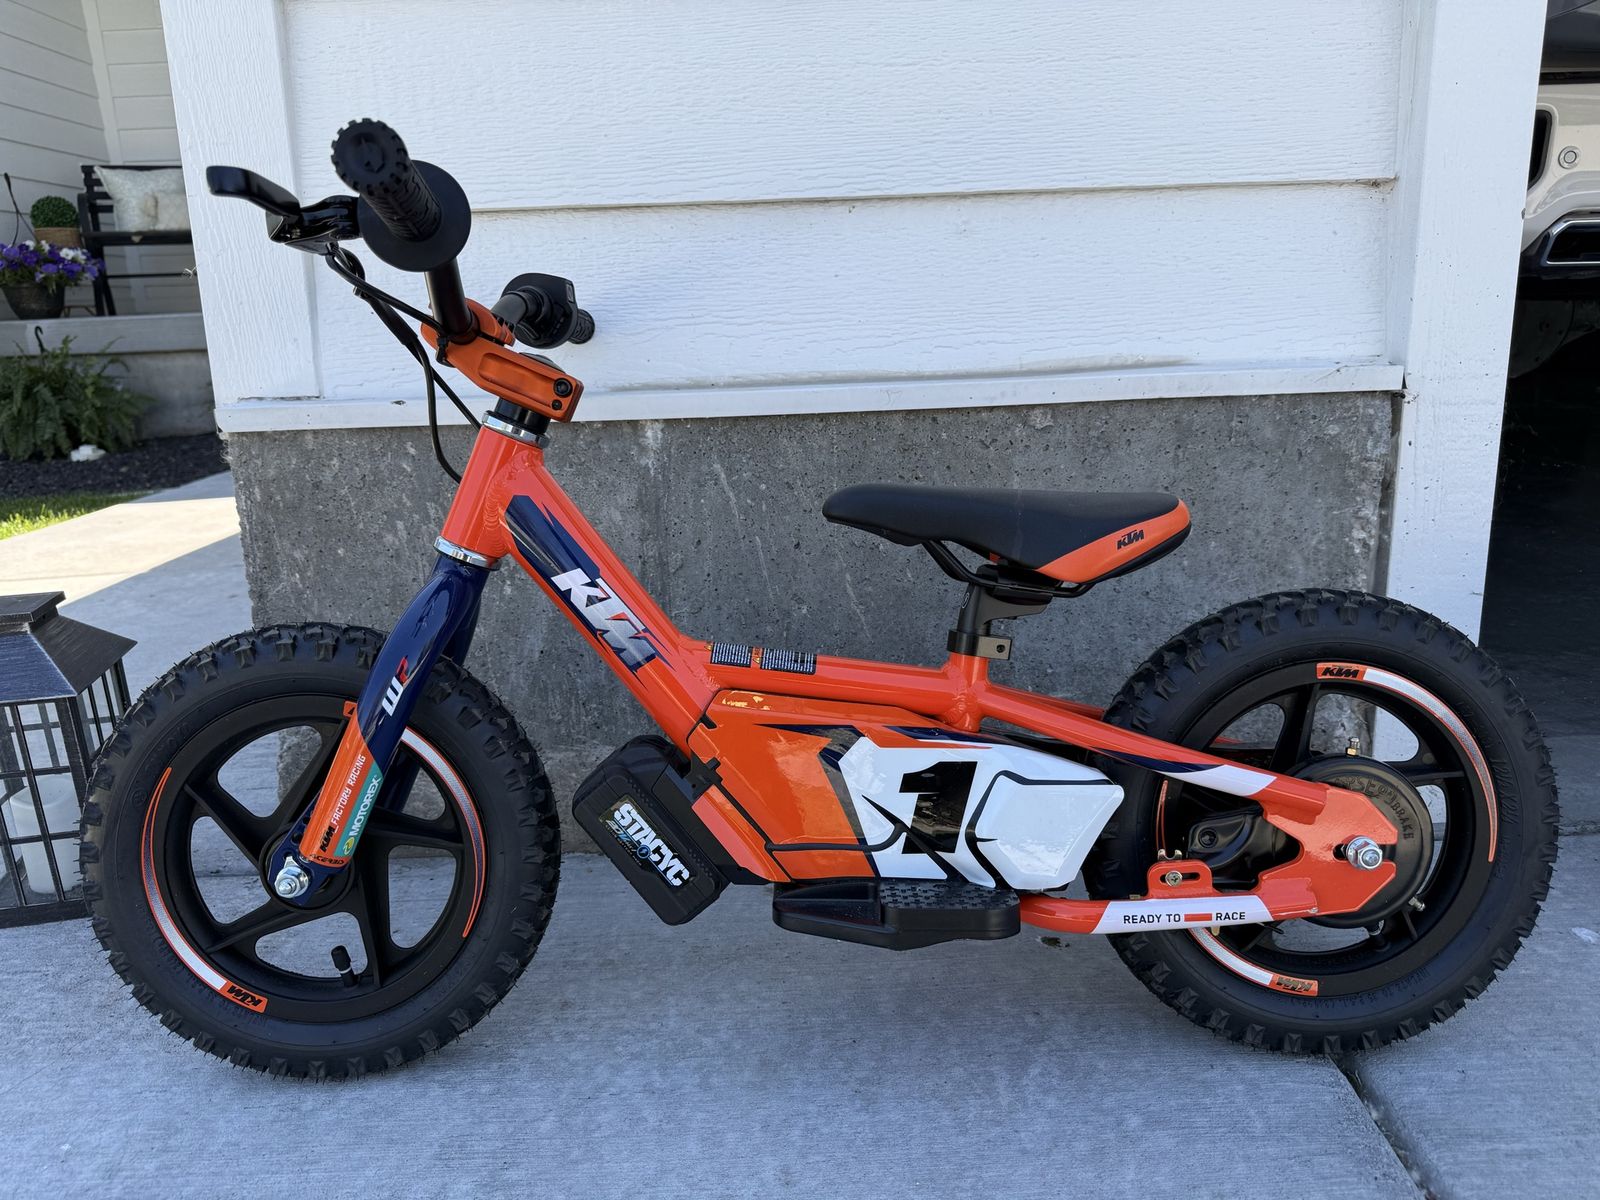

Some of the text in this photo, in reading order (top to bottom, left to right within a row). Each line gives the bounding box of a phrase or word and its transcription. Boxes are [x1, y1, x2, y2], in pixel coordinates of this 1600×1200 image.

[1116, 529, 1145, 550] KTM
[550, 567, 656, 668] KTM
[1321, 665, 1360, 679] KTM
[347, 754, 367, 787] RACING
[348, 776, 382, 837] MOTOREX
[899, 760, 978, 854] 1
[613, 803, 690, 887] STACYC
[1123, 911, 1246, 924] READY TO RACE
[226, 984, 263, 1007] KTM
[1276, 975, 1314, 993] KTM
